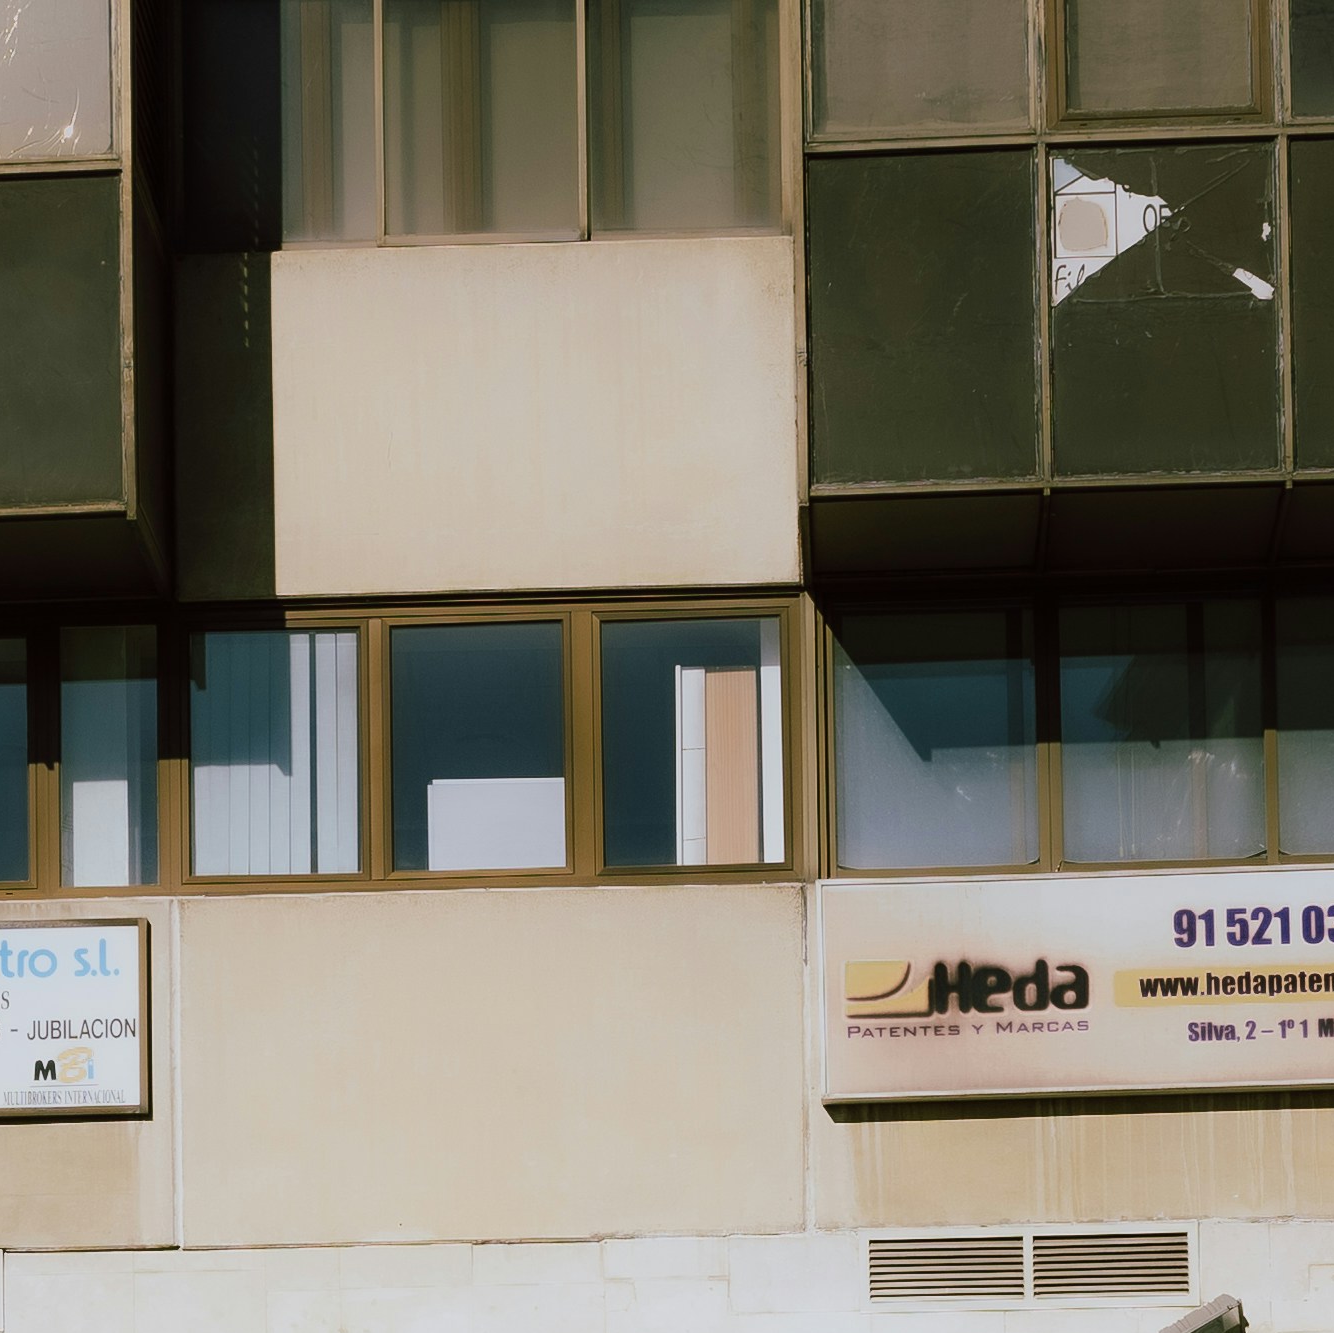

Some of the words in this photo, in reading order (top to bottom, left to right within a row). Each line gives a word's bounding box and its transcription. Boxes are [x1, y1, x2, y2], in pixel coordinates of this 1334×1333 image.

[1173, 908, 1215, 948] 91
[1226, 906, 1291, 946] 521
[73, 938, 120, 978] s.l.
[934, 958, 1090, 1015] Heda
[27, 1018, 136, 1041] JUBILACION
[847, 1024, 961, 1038] PATENTES
[972, 1023, 984, 1035] Y
[996, 1020, 1089, 1034] MARCAS
[1188, 1021, 1240, 1042] Silva,
[1245, 1020, 1257, 1040] 2
[1300, 1019, 1309, 1038] 1
[3, 1090, 62, 1106] MULTIBROKERS
[64, 1089, 126, 1105] INTERNACIONAL
